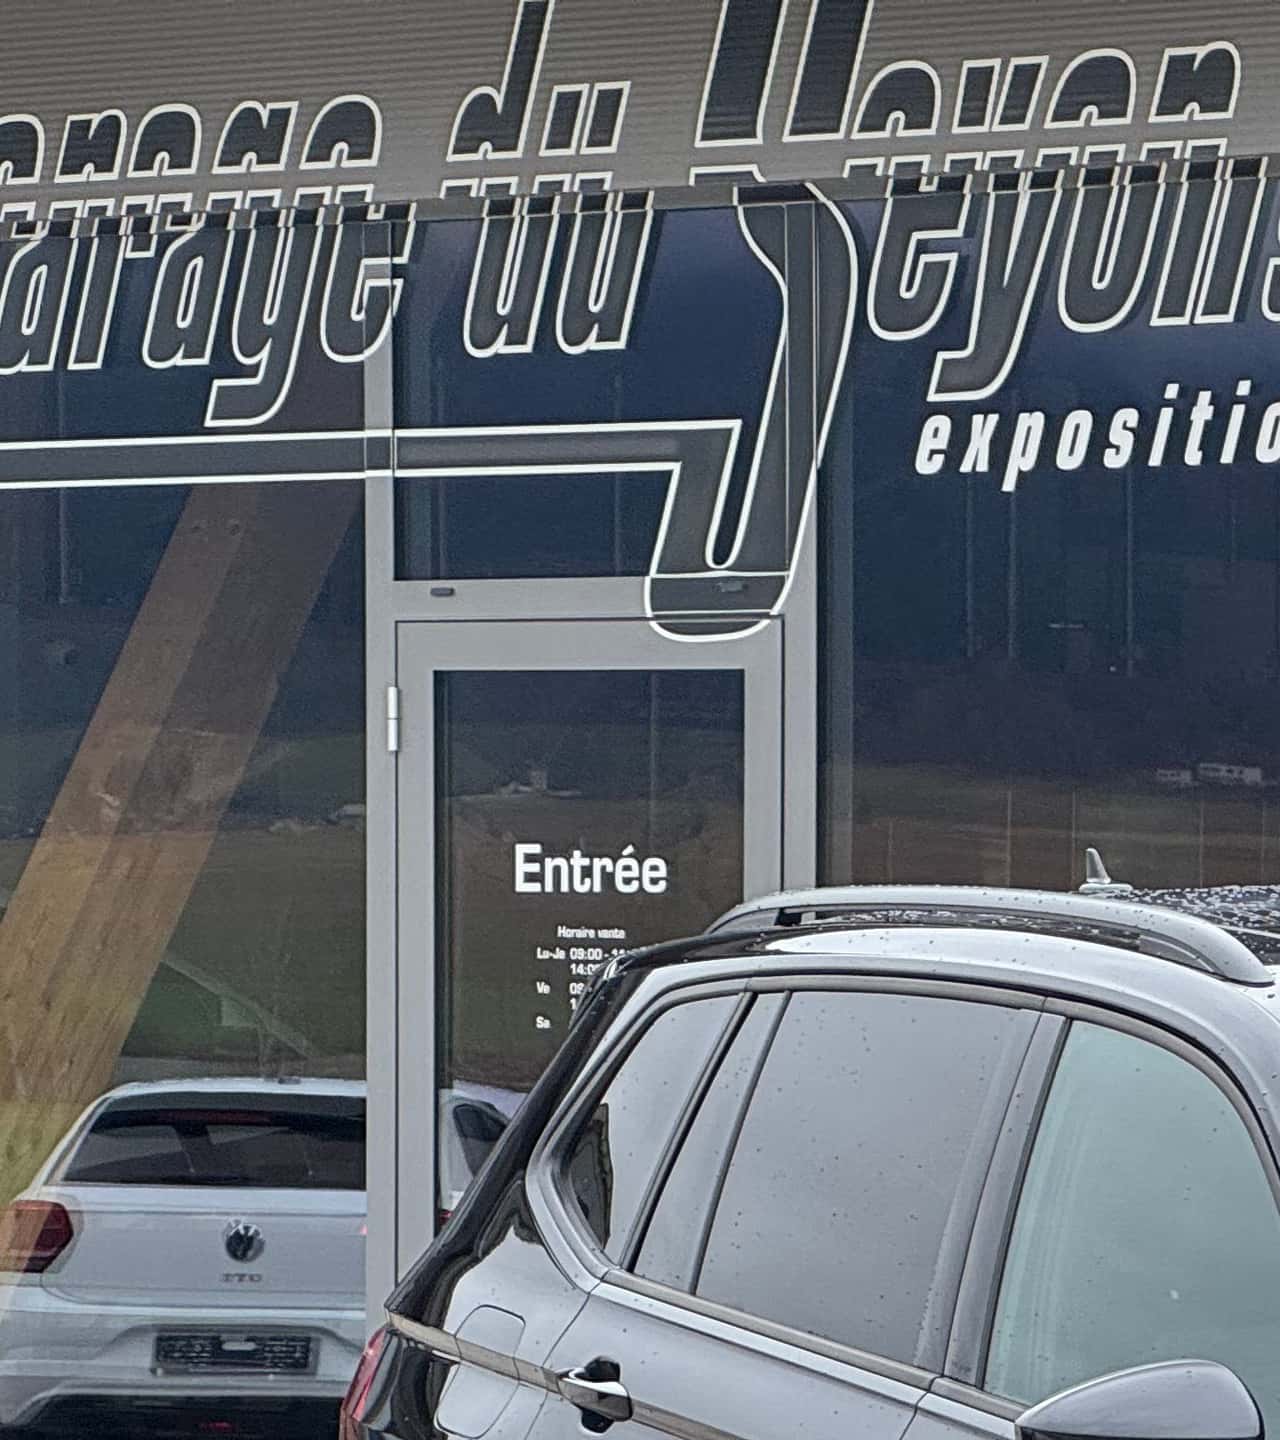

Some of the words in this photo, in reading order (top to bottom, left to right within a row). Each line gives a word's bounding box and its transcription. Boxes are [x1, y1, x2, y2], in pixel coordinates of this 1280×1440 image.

[514, 843, 668, 894] Entrée
[557, 925, 596, 939] Horaire
[598, 928, 626, 939] vente
[536, 981, 551, 994] Ve
[536, 1016, 551, 1029] Sa
